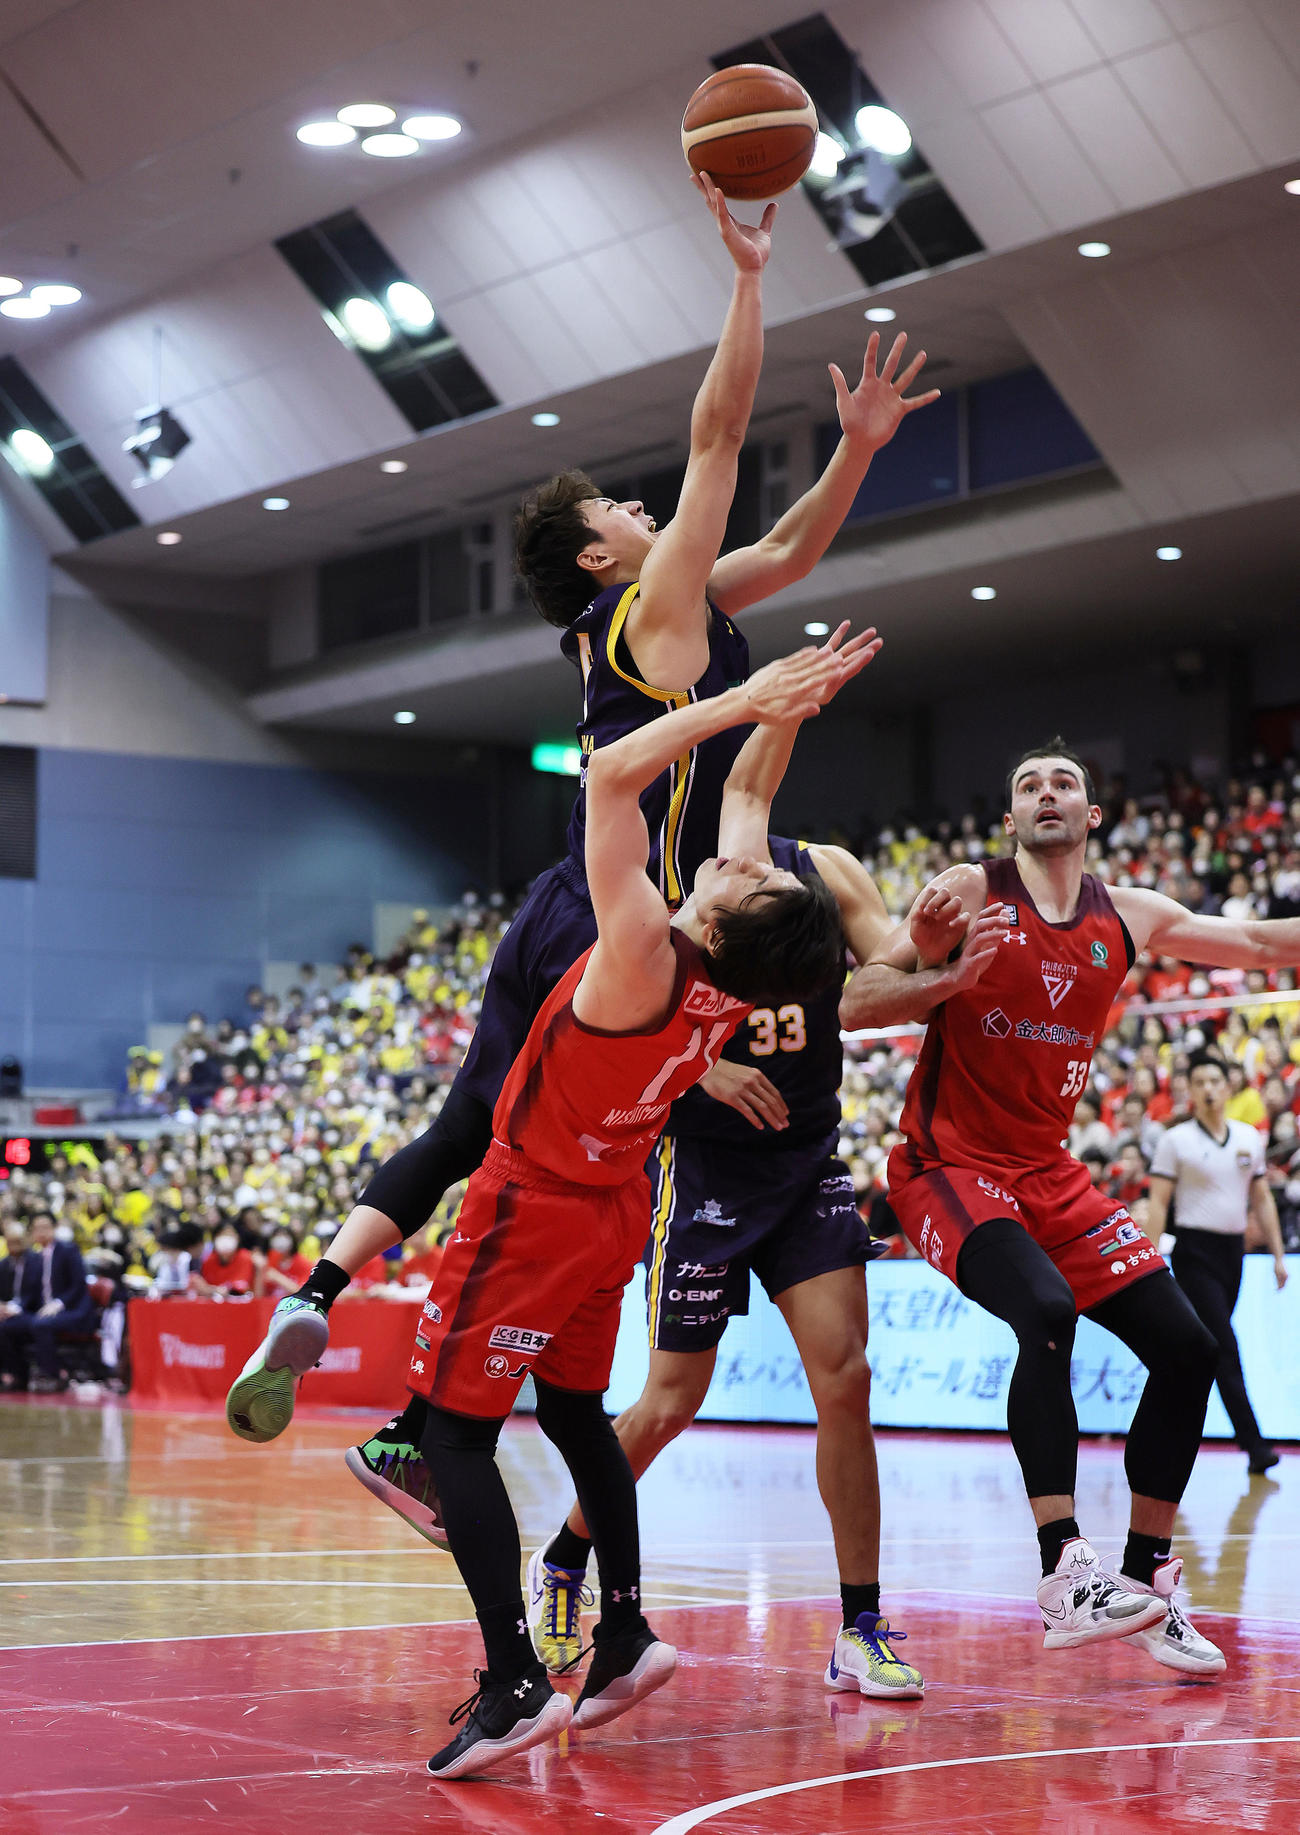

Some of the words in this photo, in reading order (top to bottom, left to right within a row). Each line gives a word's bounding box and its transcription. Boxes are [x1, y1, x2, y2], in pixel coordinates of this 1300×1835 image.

[748, 1003, 807, 1056] 33
[1060, 1060, 1088, 1097] 33
[870, 1287, 969, 1331] 天皇杯
